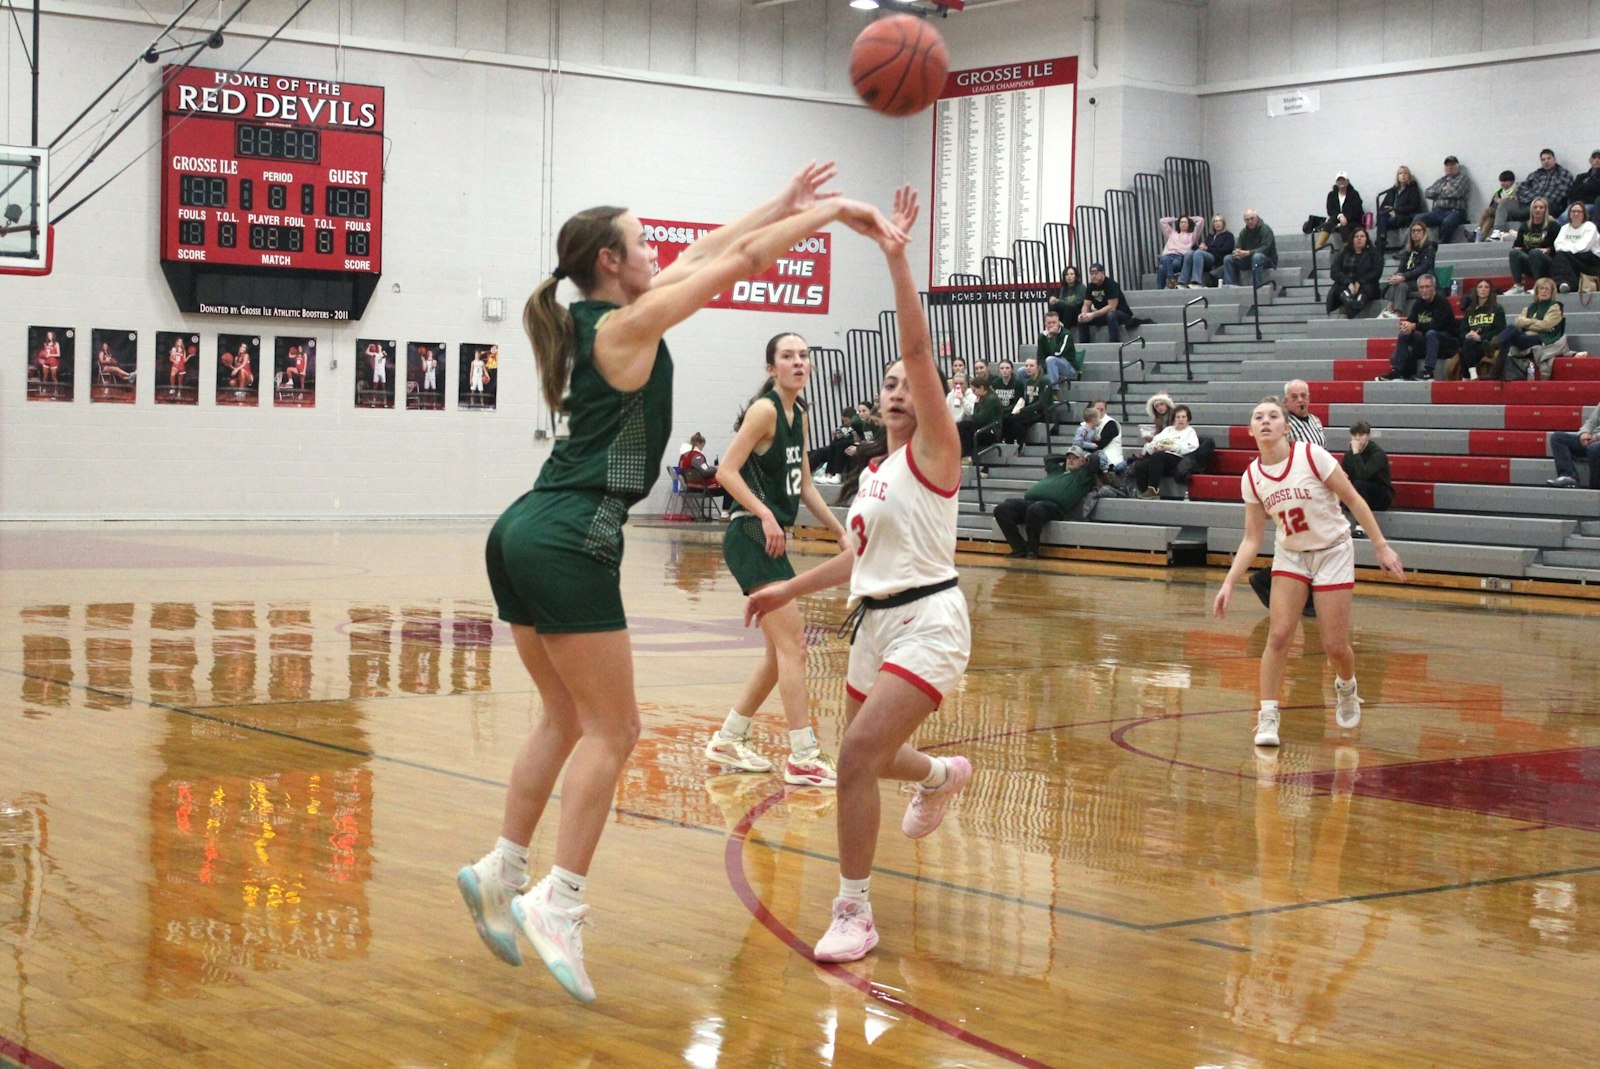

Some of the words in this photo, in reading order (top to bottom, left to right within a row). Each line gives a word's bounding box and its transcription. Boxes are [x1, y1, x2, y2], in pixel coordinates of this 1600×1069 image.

[957, 65, 1022, 86] GROSSE
[1027, 62, 1053, 78] ILE
[214, 72, 269, 88] HOME
[276, 78, 300, 92] OF
[306, 80, 340, 96] THE
[972, 84, 995, 94] LEAGUE
[996, 80, 1034, 91] CHAMPIONS
[178, 85, 246, 116] RED
[255, 92, 376, 128] DEVILS
[172, 156, 218, 173] GROSSE
[219, 160, 238, 174] ILE
[263, 172, 293, 183] PERIOD
[329, 169, 368, 185] GUEST
[178, 209, 206, 220] FOULS
[216, 212, 240, 222] T.O.L.
[248, 214, 280, 226] PLAYER
[284, 216, 306, 228] FOUL
[314, 218, 336, 230] T.O.L.
[345, 221, 371, 232] FOULS
[643, 224, 694, 244] ROSSE
[178, 249, 206, 261] SCORE
[262, 254, 291, 266] MATCH
[344, 260, 370, 270] SCORE
[776, 259, 814, 276] THE
[732, 280, 824, 306] DEVILS
[200, 304, 228, 314] DONATED
[240, 306, 261, 316] GROSSE
[263, 306, 272, 316] ILE
[273, 308, 300, 318] ATHLETIC
[302, 308, 330, 319] BOOSTERS
[334, 310, 349, 320] 2011
[786, 468, 802, 496] 12
[869, 480, 888, 502] ILE
[1293, 488, 1312, 500] ILE
[1278, 507, 1310, 536] 12
[851, 514, 868, 557] 3
